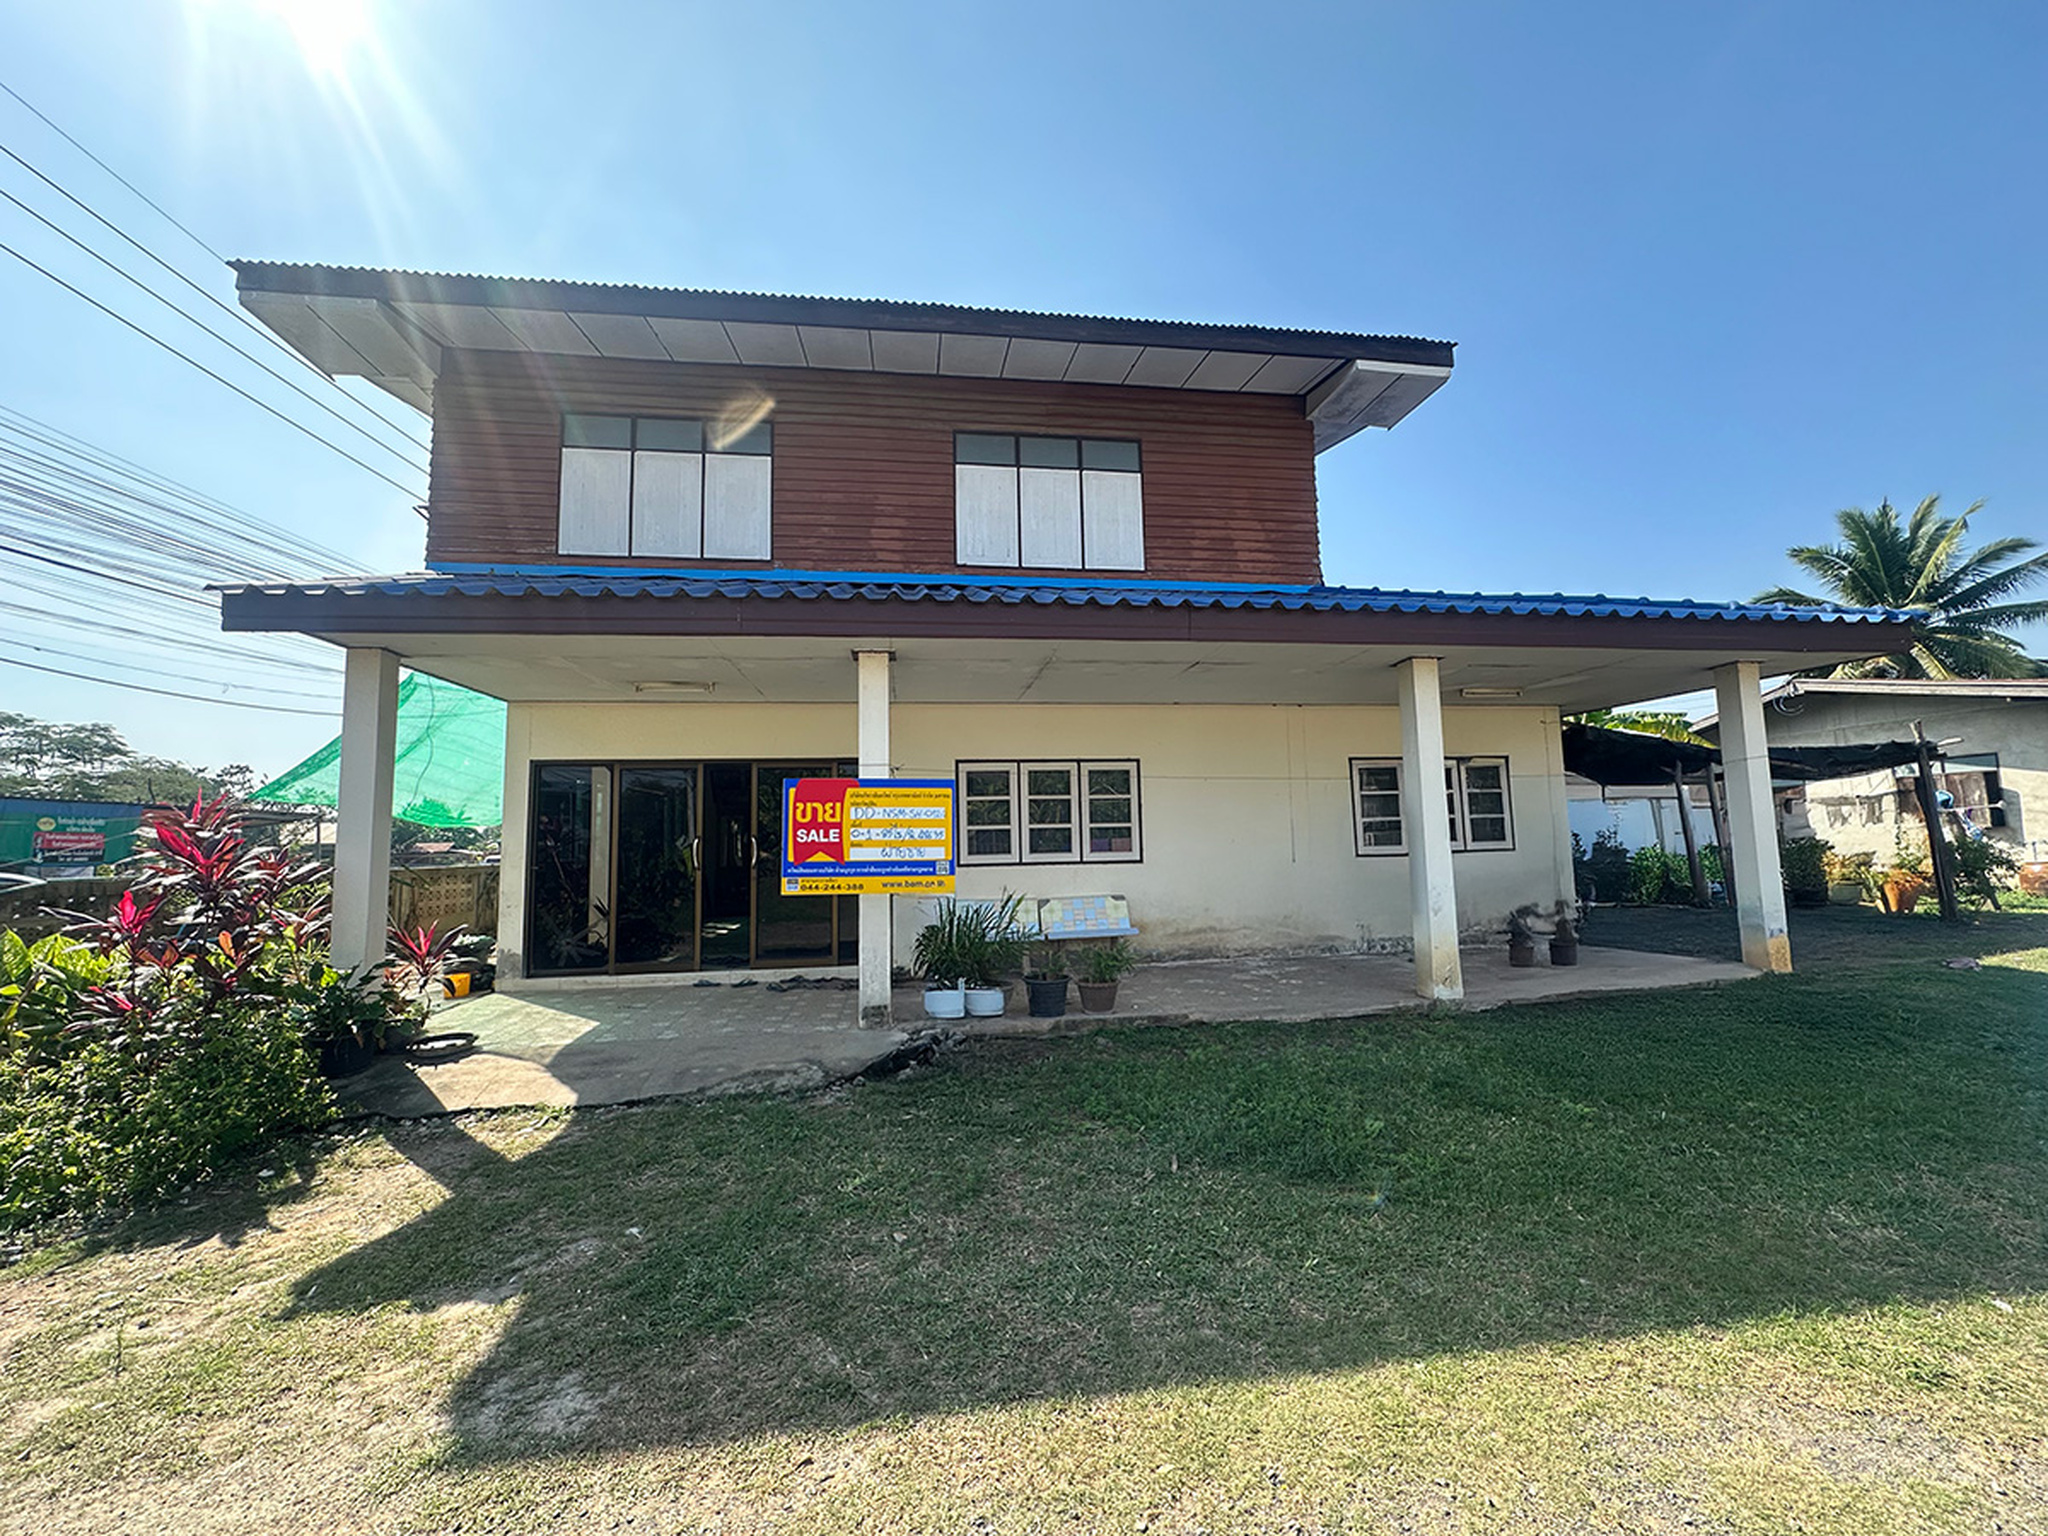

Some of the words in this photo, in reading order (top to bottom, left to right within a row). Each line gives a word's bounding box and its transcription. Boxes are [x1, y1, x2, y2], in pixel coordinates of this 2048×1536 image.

[796, 802, 841, 823] ขาย
[796, 829, 840, 843] SALE
[800, 883, 864, 891] 044-244-388
